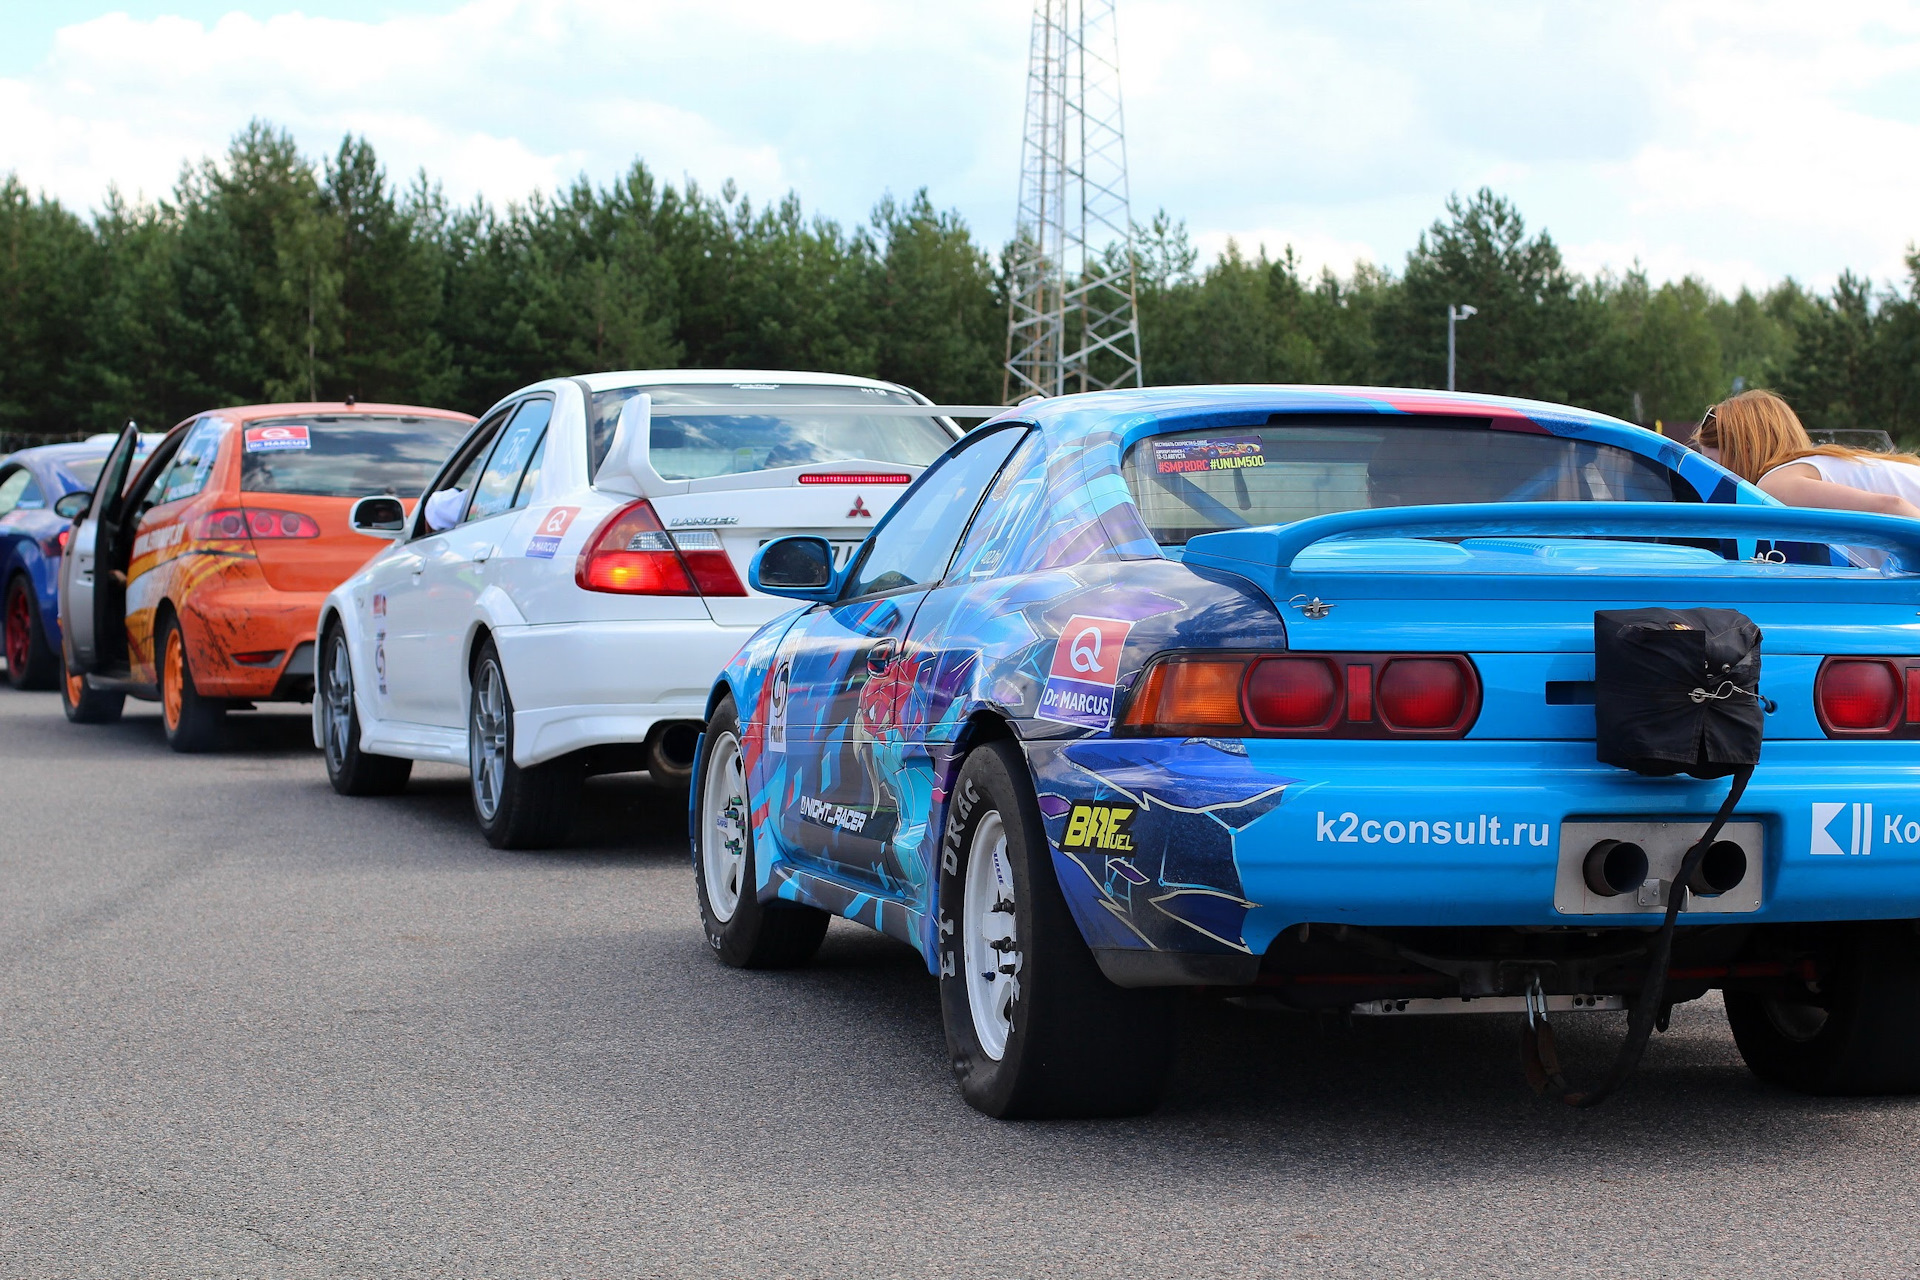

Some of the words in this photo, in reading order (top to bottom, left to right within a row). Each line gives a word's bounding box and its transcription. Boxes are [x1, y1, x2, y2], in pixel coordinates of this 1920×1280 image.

[1158, 460, 1184, 473] #SMP
[1185, 459, 1209, 472] RDRC
[1209, 455, 1266, 470] #UNLIM500
[670, 516, 740, 527] LANCER
[1043, 688, 1059, 708] Dr.
[1059, 690, 1109, 716] MARCUS
[942, 778, 981, 877] DRAG
[1316, 811, 1550, 846] k2consult.ru
